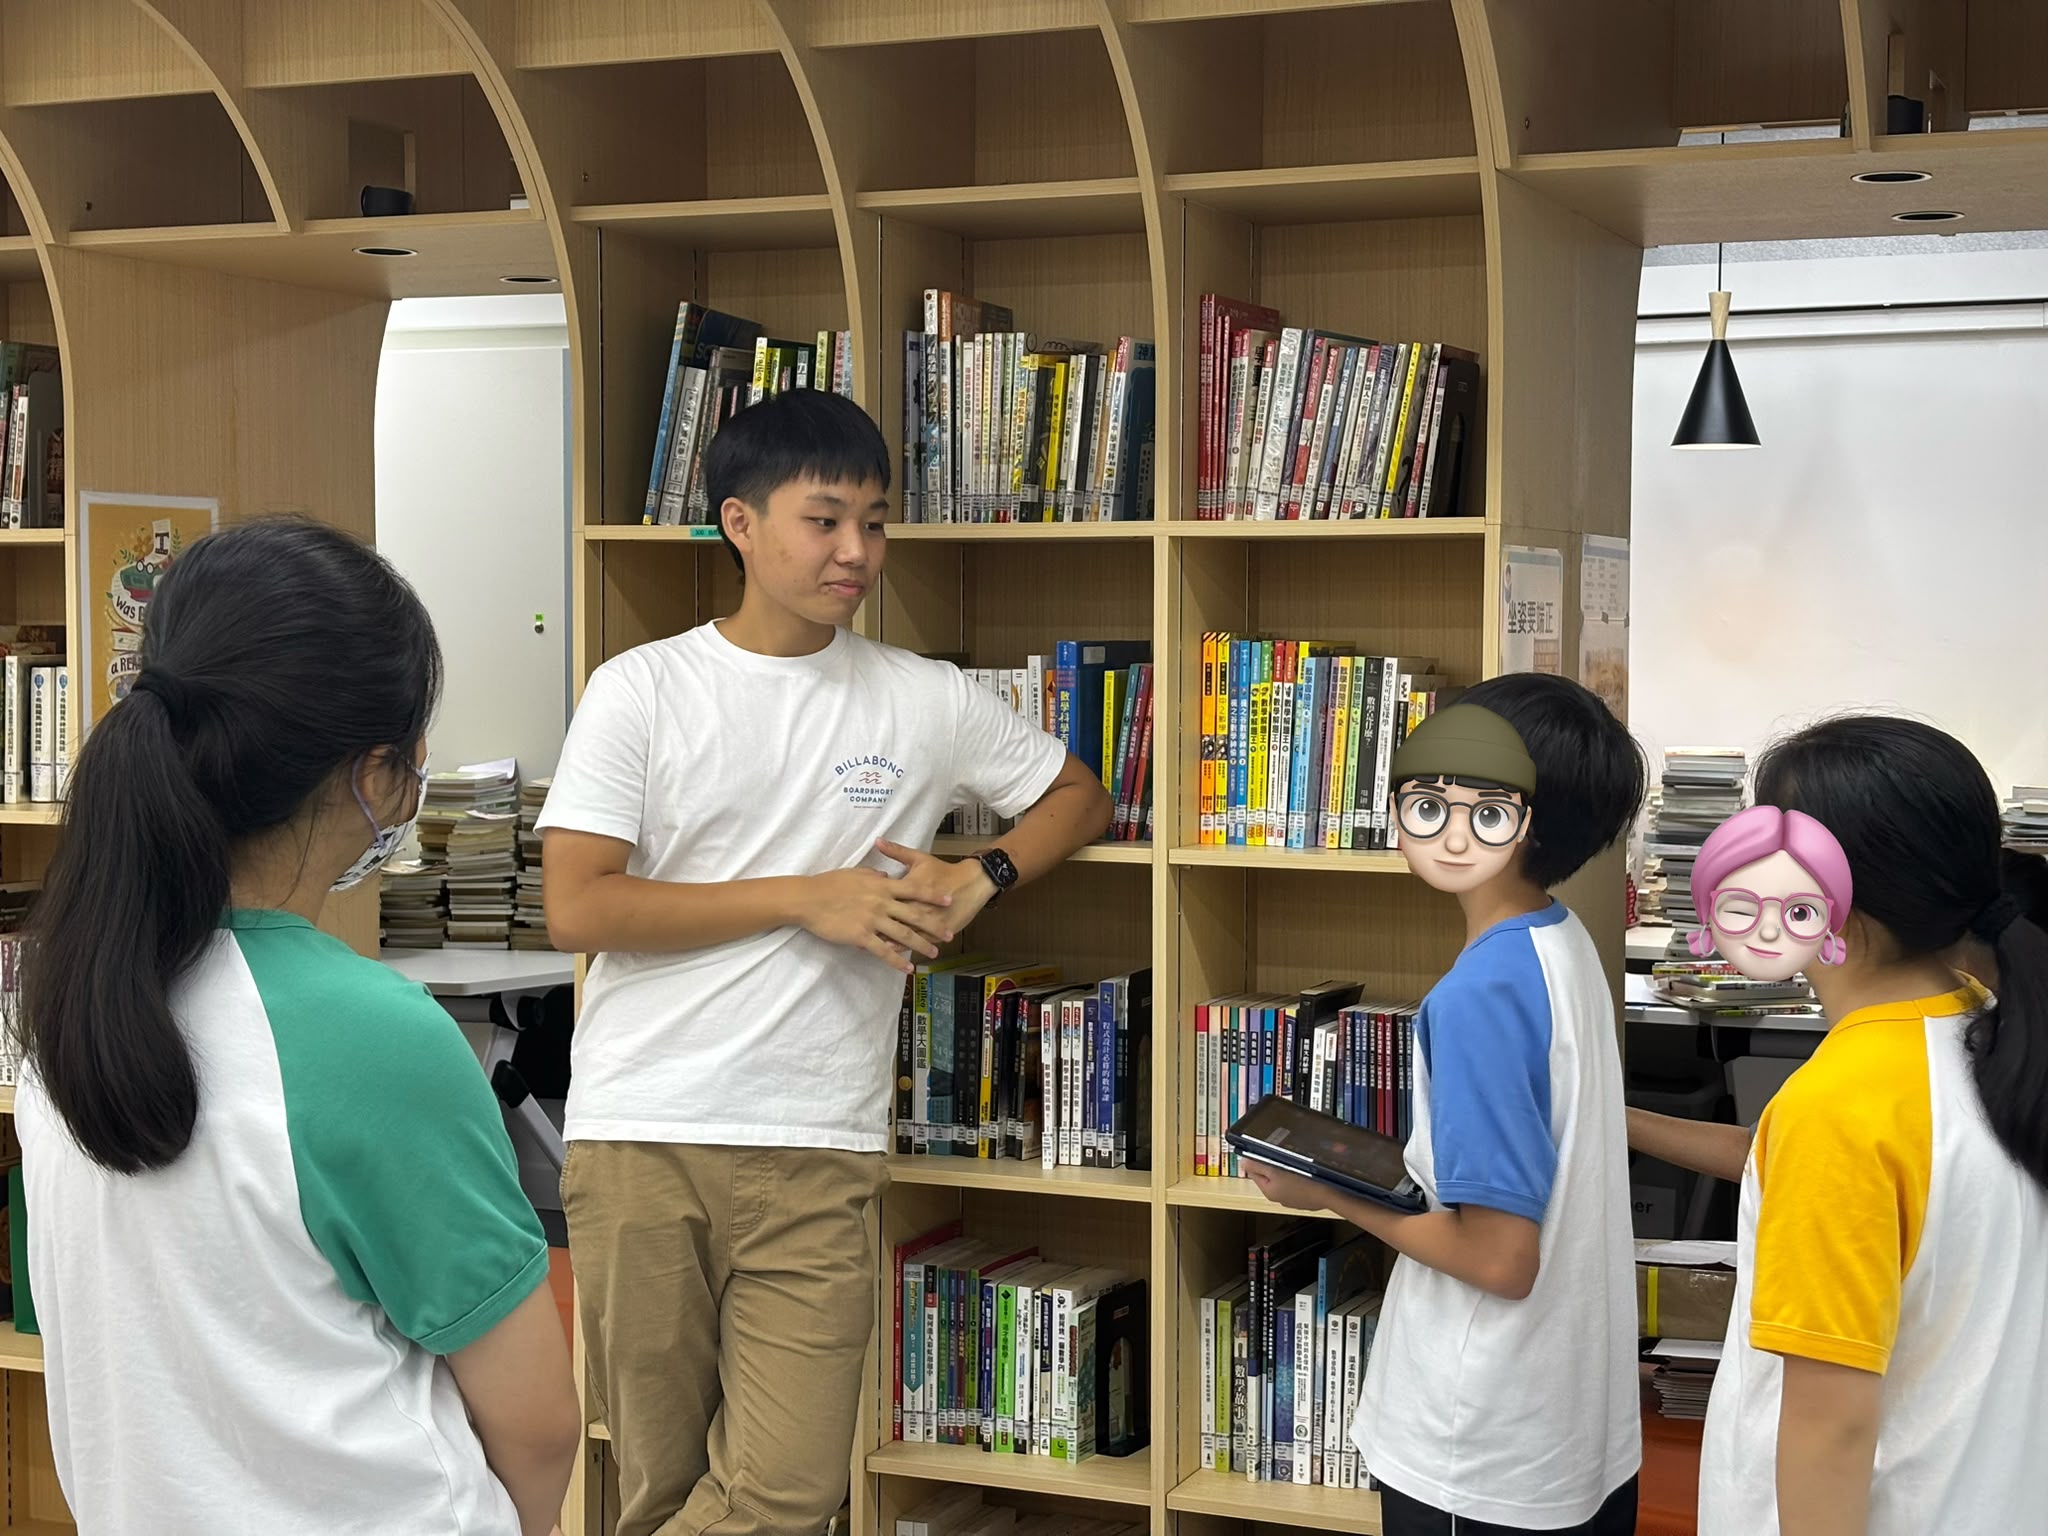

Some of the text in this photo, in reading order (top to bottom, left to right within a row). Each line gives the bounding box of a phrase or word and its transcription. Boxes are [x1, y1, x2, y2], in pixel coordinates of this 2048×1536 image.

[155, 531, 169, 555] I
[1508, 600, 1553, 634] 坐姿要端正
[834, 755, 904, 779] BILLABONG
[843, 786, 894, 795] BOARDSHORT
[849, 796, 887, 804] COMPANY
[916, 1014, 927, 1069] 數學大圖鑑
[1234, 1364, 1246, 1420] 數學故事
